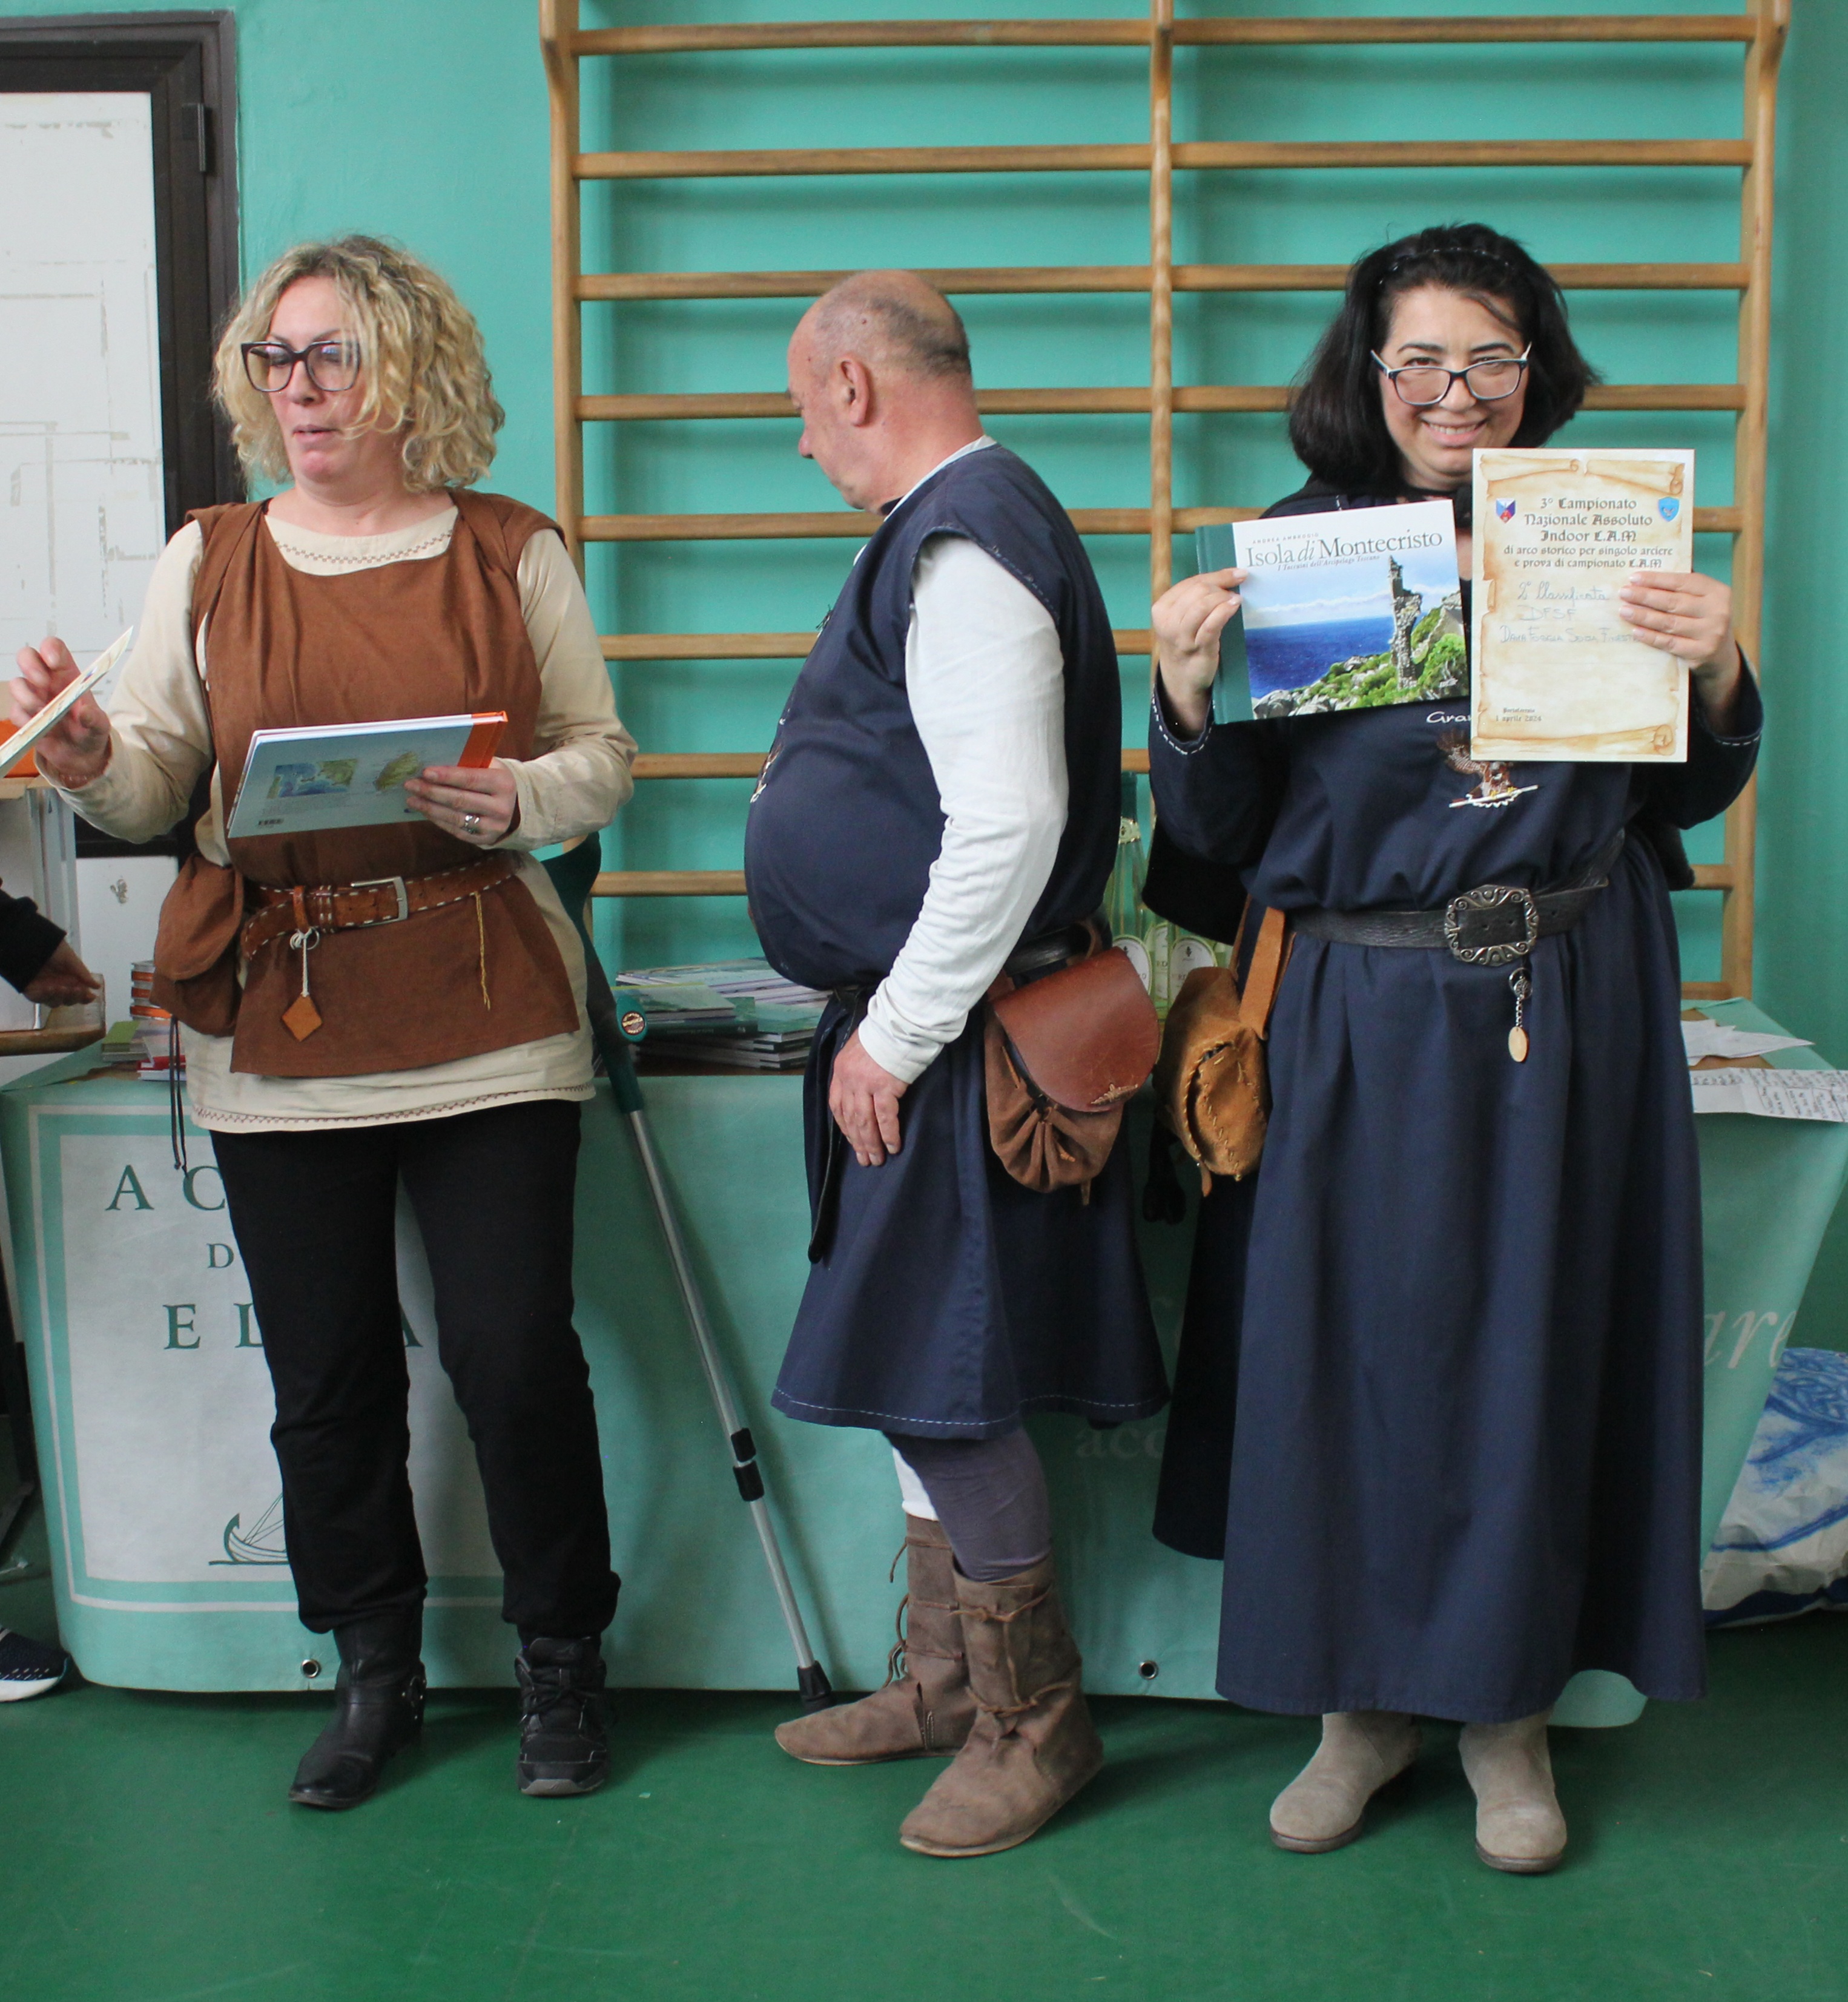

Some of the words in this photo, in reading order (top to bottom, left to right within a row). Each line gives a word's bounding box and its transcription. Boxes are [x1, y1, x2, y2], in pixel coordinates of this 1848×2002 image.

[1558, 497, 1637, 511] Campionato
[1523, 513, 1587, 527] Nazionale
[1591, 513, 1653, 525] Assoluto
[1282, 532, 1319, 542] AMBROGIO
[1540, 530, 1590, 542] Indoor
[1246, 544, 1295, 568] Isola
[1297, 539, 1316, 562] di
[1318, 528, 1444, 559] Montecristo
[1503, 545, 1514, 555] di
[1517, 546, 1538, 555] arco
[1541, 545, 1576, 555] storico
[1579, 547, 1596, 556] per
[1598, 545, 1638, 556] singolo
[1640, 545, 1673, 555] arciere
[1514, 559, 1520, 568] e
[1523, 559, 1551, 569] prova
[1554, 558, 1565, 568] di
[1567, 559, 1626, 569] campionato
